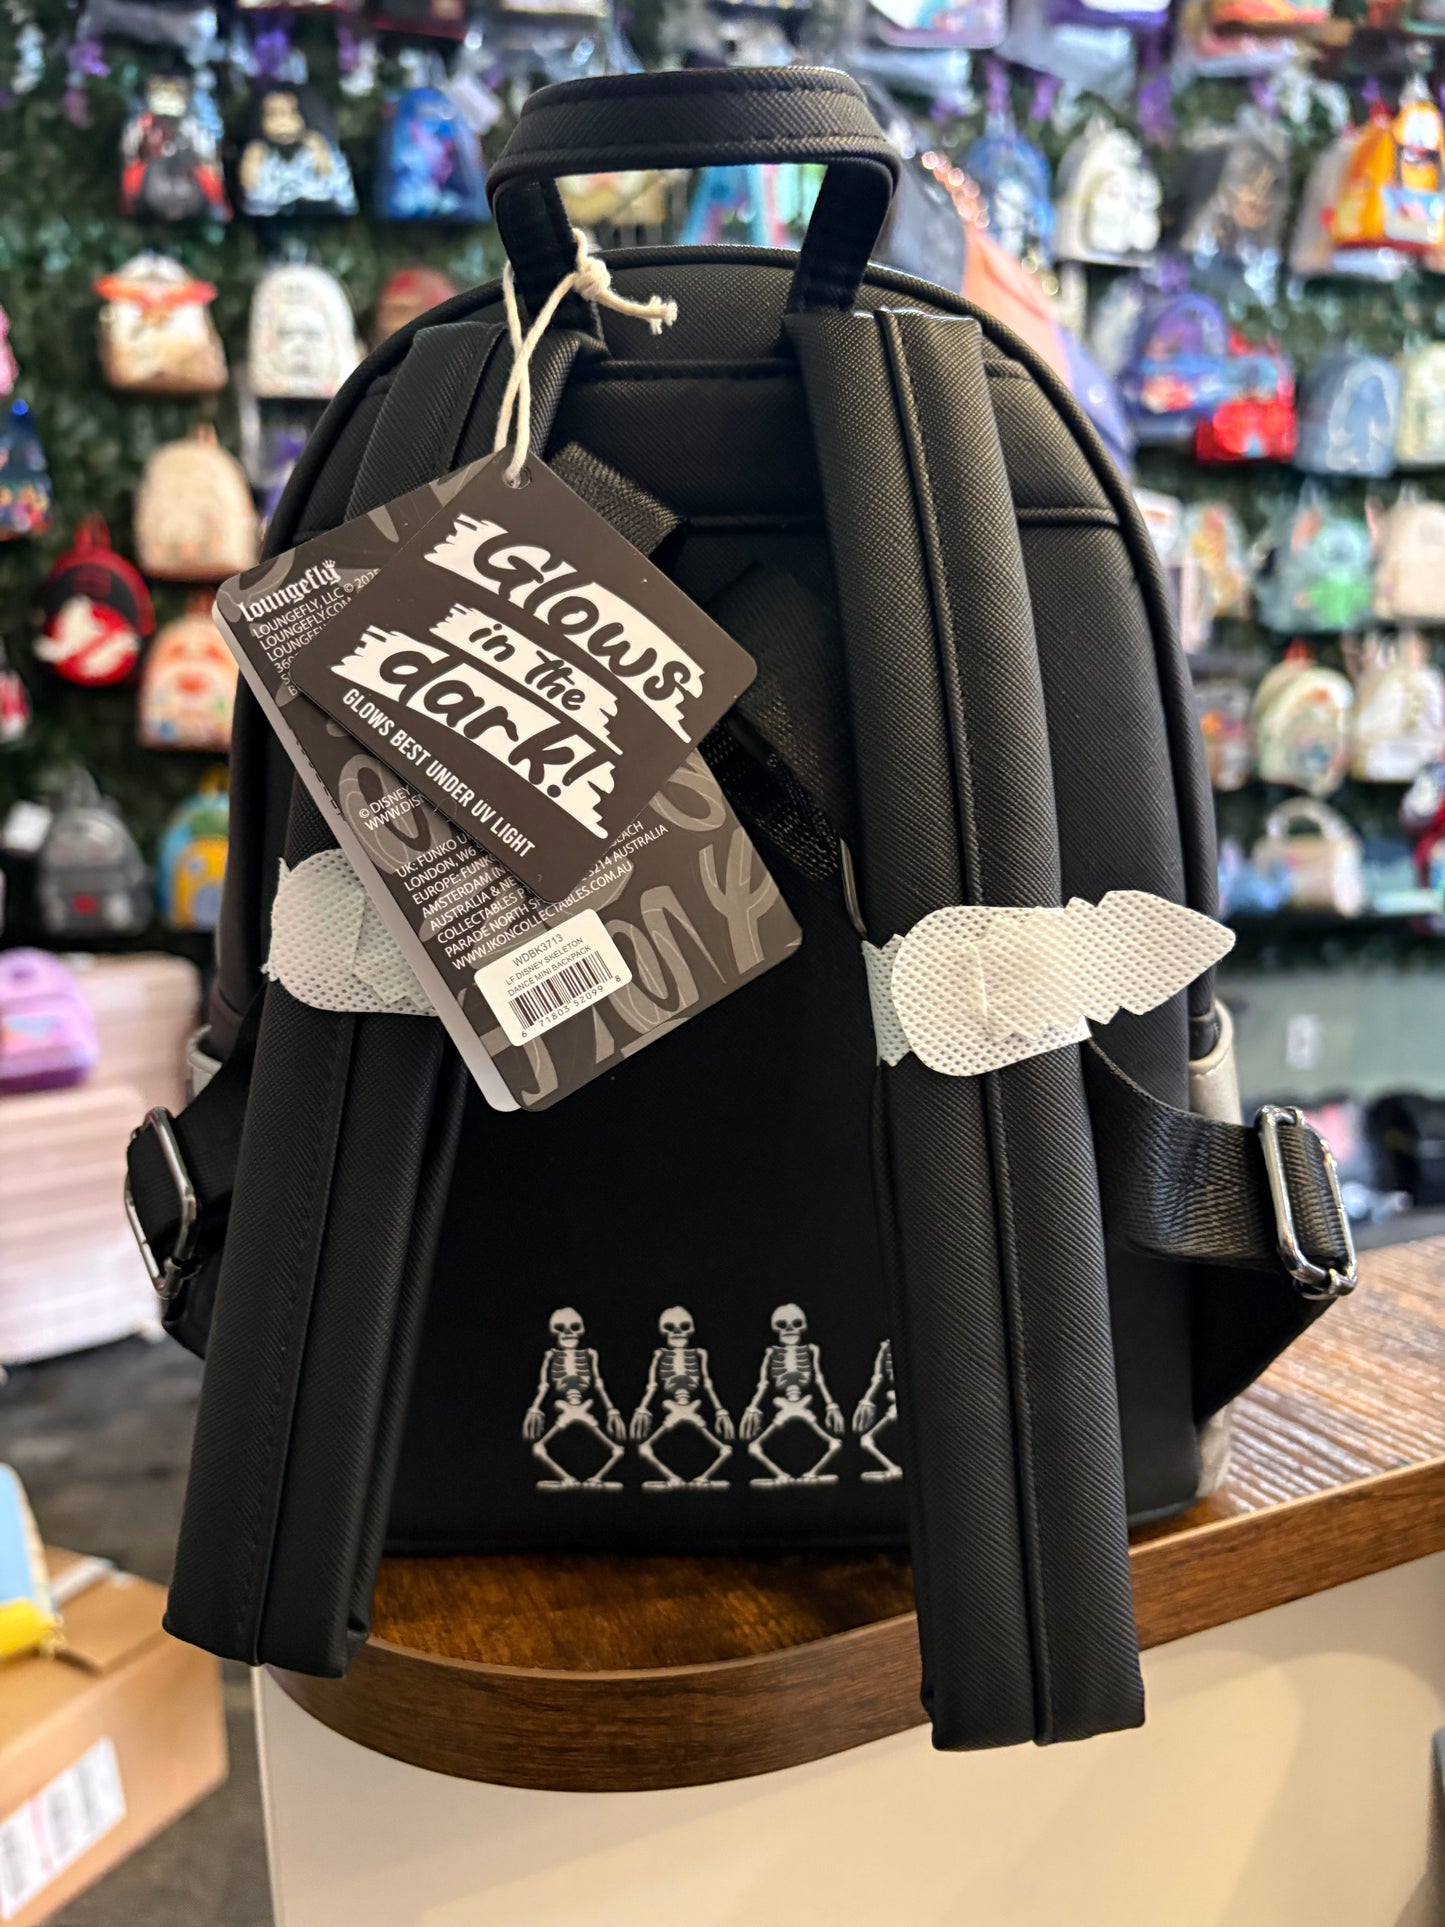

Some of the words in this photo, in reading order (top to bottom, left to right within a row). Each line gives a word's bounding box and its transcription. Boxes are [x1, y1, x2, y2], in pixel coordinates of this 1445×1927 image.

[237, 563, 341, 622] loungefly
[252, 599, 323, 639] LOUNGEFLY,
[321, 587, 344, 605] LLC
[473, 532, 691, 701] Glows
[469, 623, 515, 662] in
[525, 650, 586, 711] the
[379, 650, 608, 798] dark!
[342, 688, 395, 737] GLOWS
[389, 729, 431, 767] BEST
[426, 760, 475, 808] UNDER
[471, 799, 496, 824] UV
[490, 816, 535, 857] LIGHT
[369, 784, 411, 814] DISNEY
[396, 859, 419, 879] UK:
[416, 839, 457, 868] FUNKO
[404, 858, 459, 892] LONDON,
[456, 845, 477, 862] W6
[613, 824, 669, 862] AUSTRALIA
[412, 873, 462, 905] EUROPE:
[421, 872, 492, 918] AMSTERDAM
[430, 891, 491, 931] AUSTRALIA
[490, 885, 500, 897] &
[437, 892, 518, 944] COLLECTABLES
[444, 926, 491, 958] PARADE
[489, 903, 529, 930] NORTH
[452, 860, 633, 971] WWW.IKONCOLLECTABLES.COM.AU
[505, 976, 516, 986] LF
[513, 961, 544, 982] DISNEY
[544, 937, 584, 963] SKELETON
[507, 978, 535, 997] DANCE
[535, 967, 551, 982] MINI
[551, 944, 592, 972] BACKPACK
[512, 933, 564, 967] WDBK3713
[521, 1030, 528, 1038] 6
[538, 1005, 570, 1028] 71803
[573, 985, 604, 1007] 52099
[614, 974, 622, 983] 8
